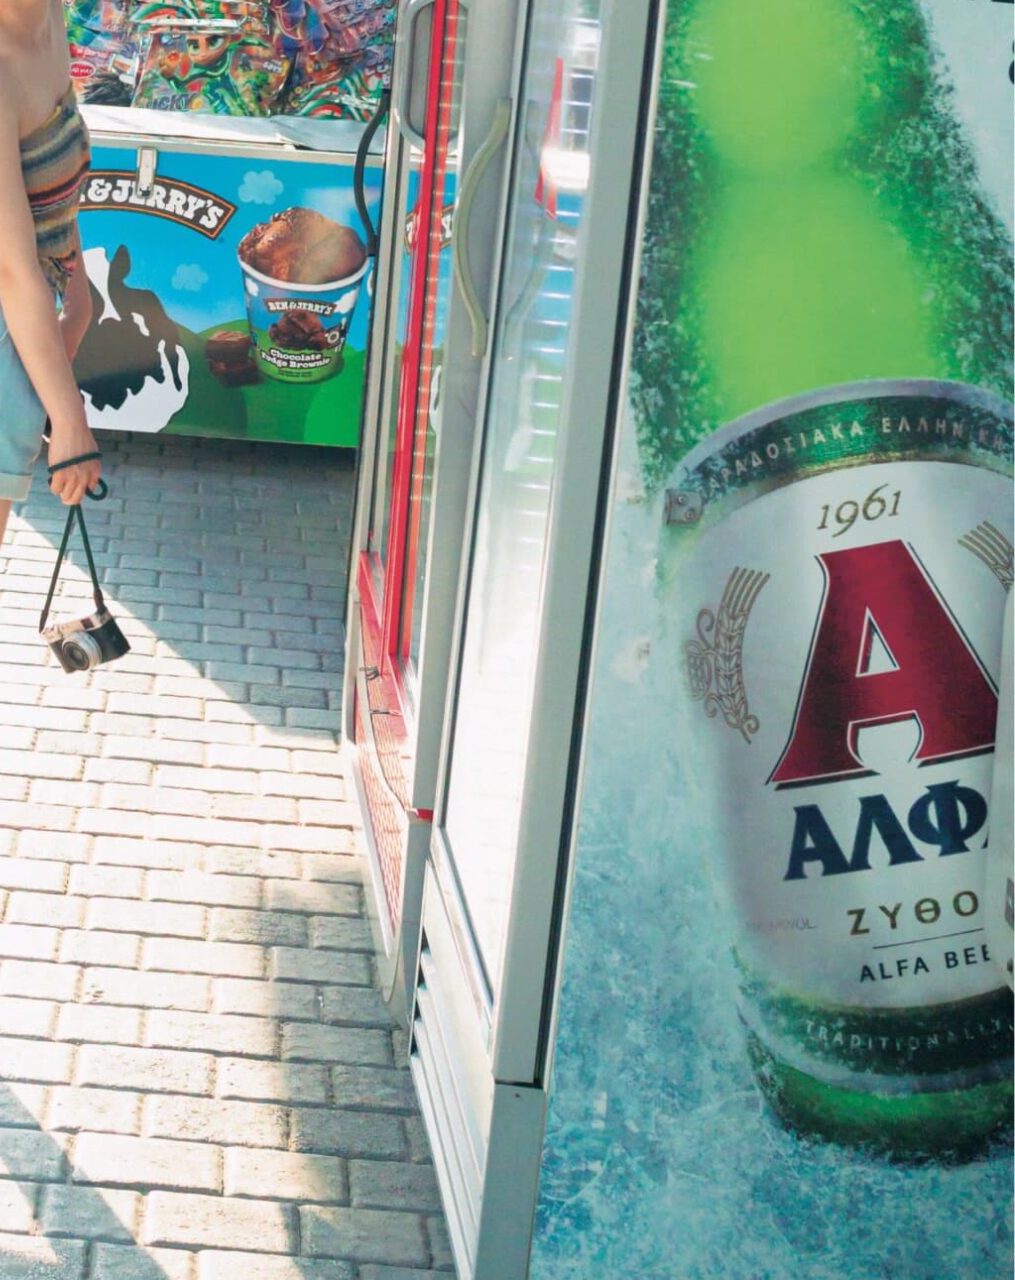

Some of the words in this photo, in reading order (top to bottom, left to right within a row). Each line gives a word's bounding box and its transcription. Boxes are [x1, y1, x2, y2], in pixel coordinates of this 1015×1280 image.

[270, 349, 322, 362] Chocolate
[816, 483, 903, 538] 1961
[782, 779, 989, 881] ΑΛΦ
[859, 957, 930, 983] ALFA
